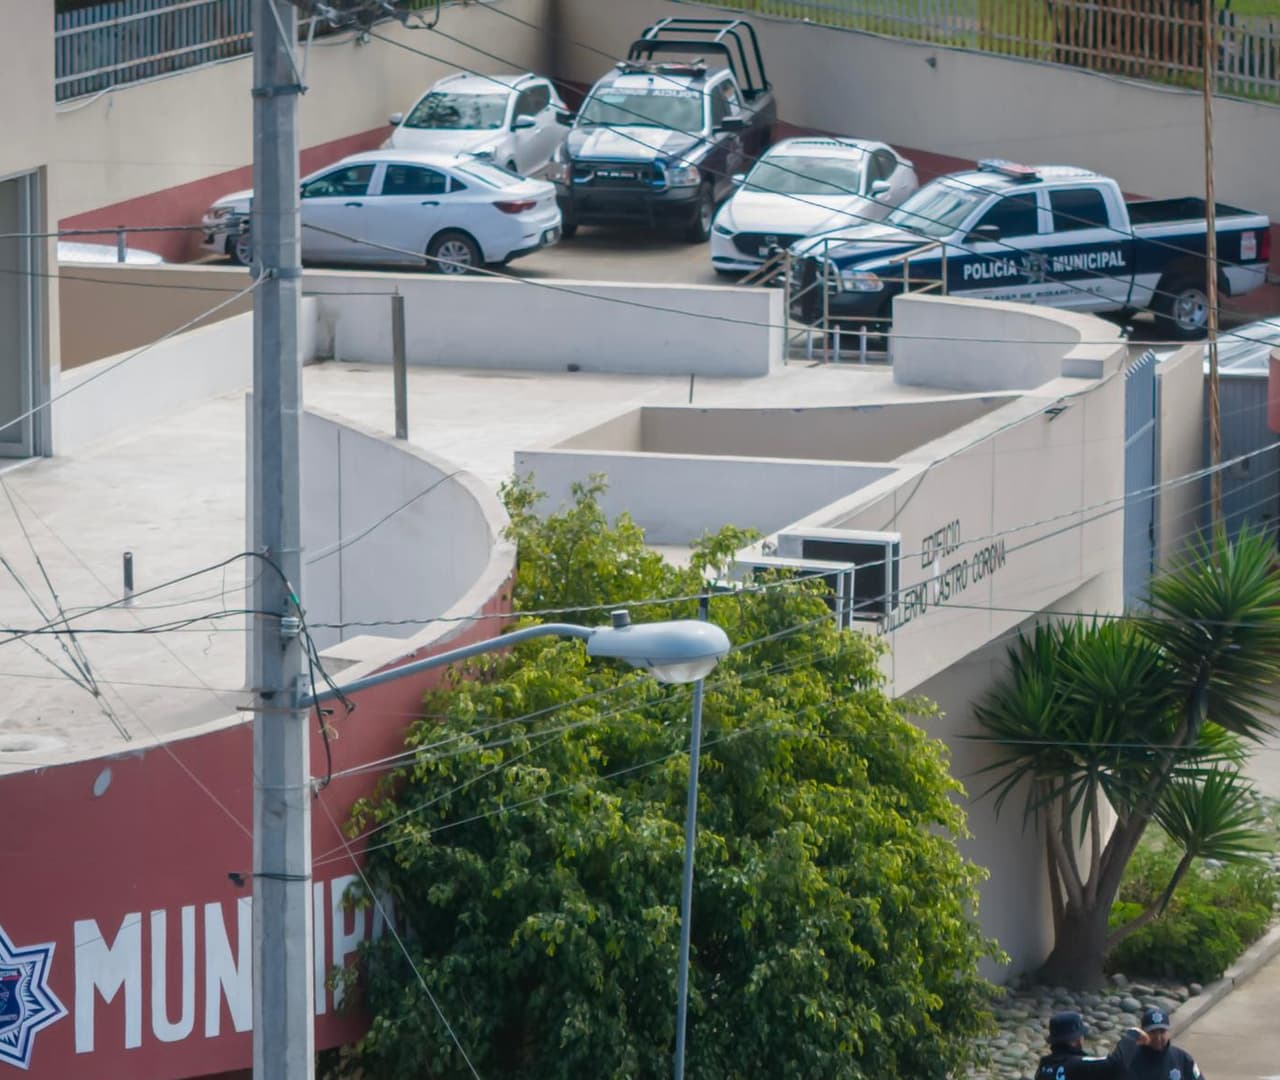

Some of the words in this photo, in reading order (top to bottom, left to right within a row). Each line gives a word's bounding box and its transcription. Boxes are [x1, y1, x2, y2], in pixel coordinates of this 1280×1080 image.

[963, 257, 1018, 280] POLICÍA
[1052, 250, 1126, 272] MUNICIPAL
[921, 519, 961, 569] EDIFICIO
[972, 540, 1006, 583] CORONA
[73, 874, 406, 1054] MUNIP
